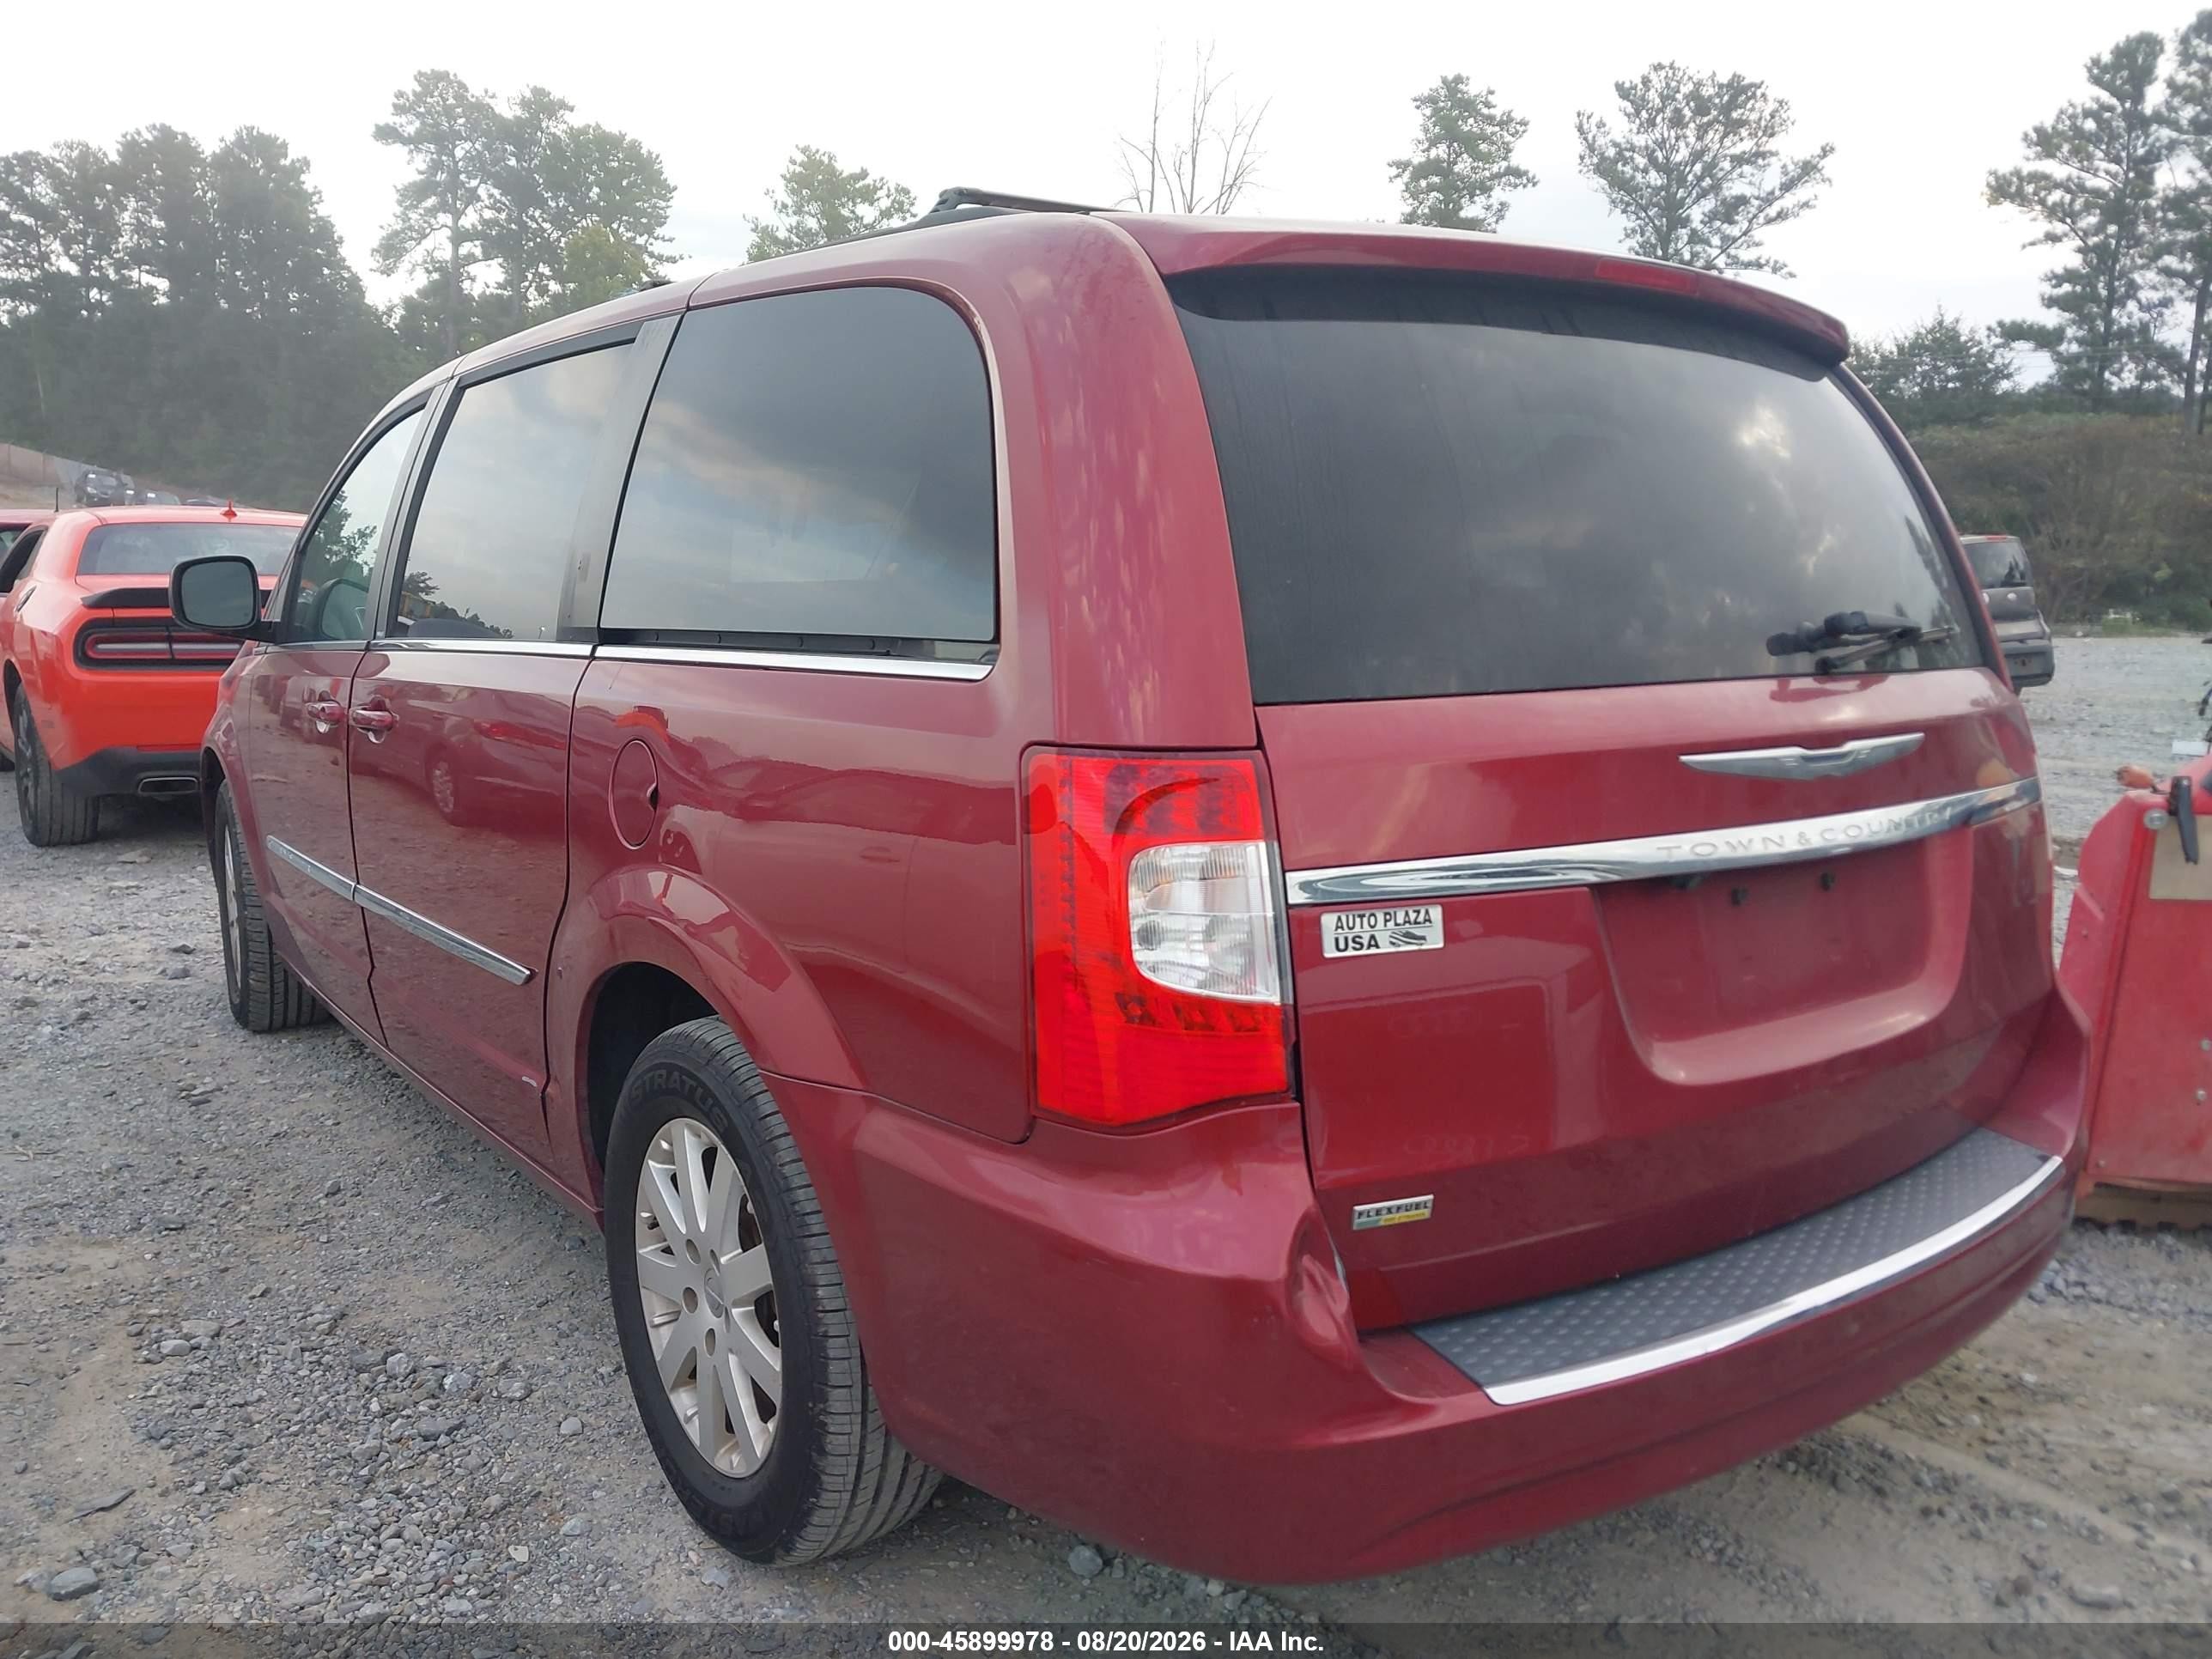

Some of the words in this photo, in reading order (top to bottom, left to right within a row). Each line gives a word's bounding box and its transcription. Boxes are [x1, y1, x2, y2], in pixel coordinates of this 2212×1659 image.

[1334, 912, 1378, 933] AUTO
[1383, 908, 1433, 927] PLAZA
[1334, 933, 1381, 953] USA
[629, 1068, 729, 1133] STRATUS
[1358, 1201, 1429, 1219] FLEXFUEL
